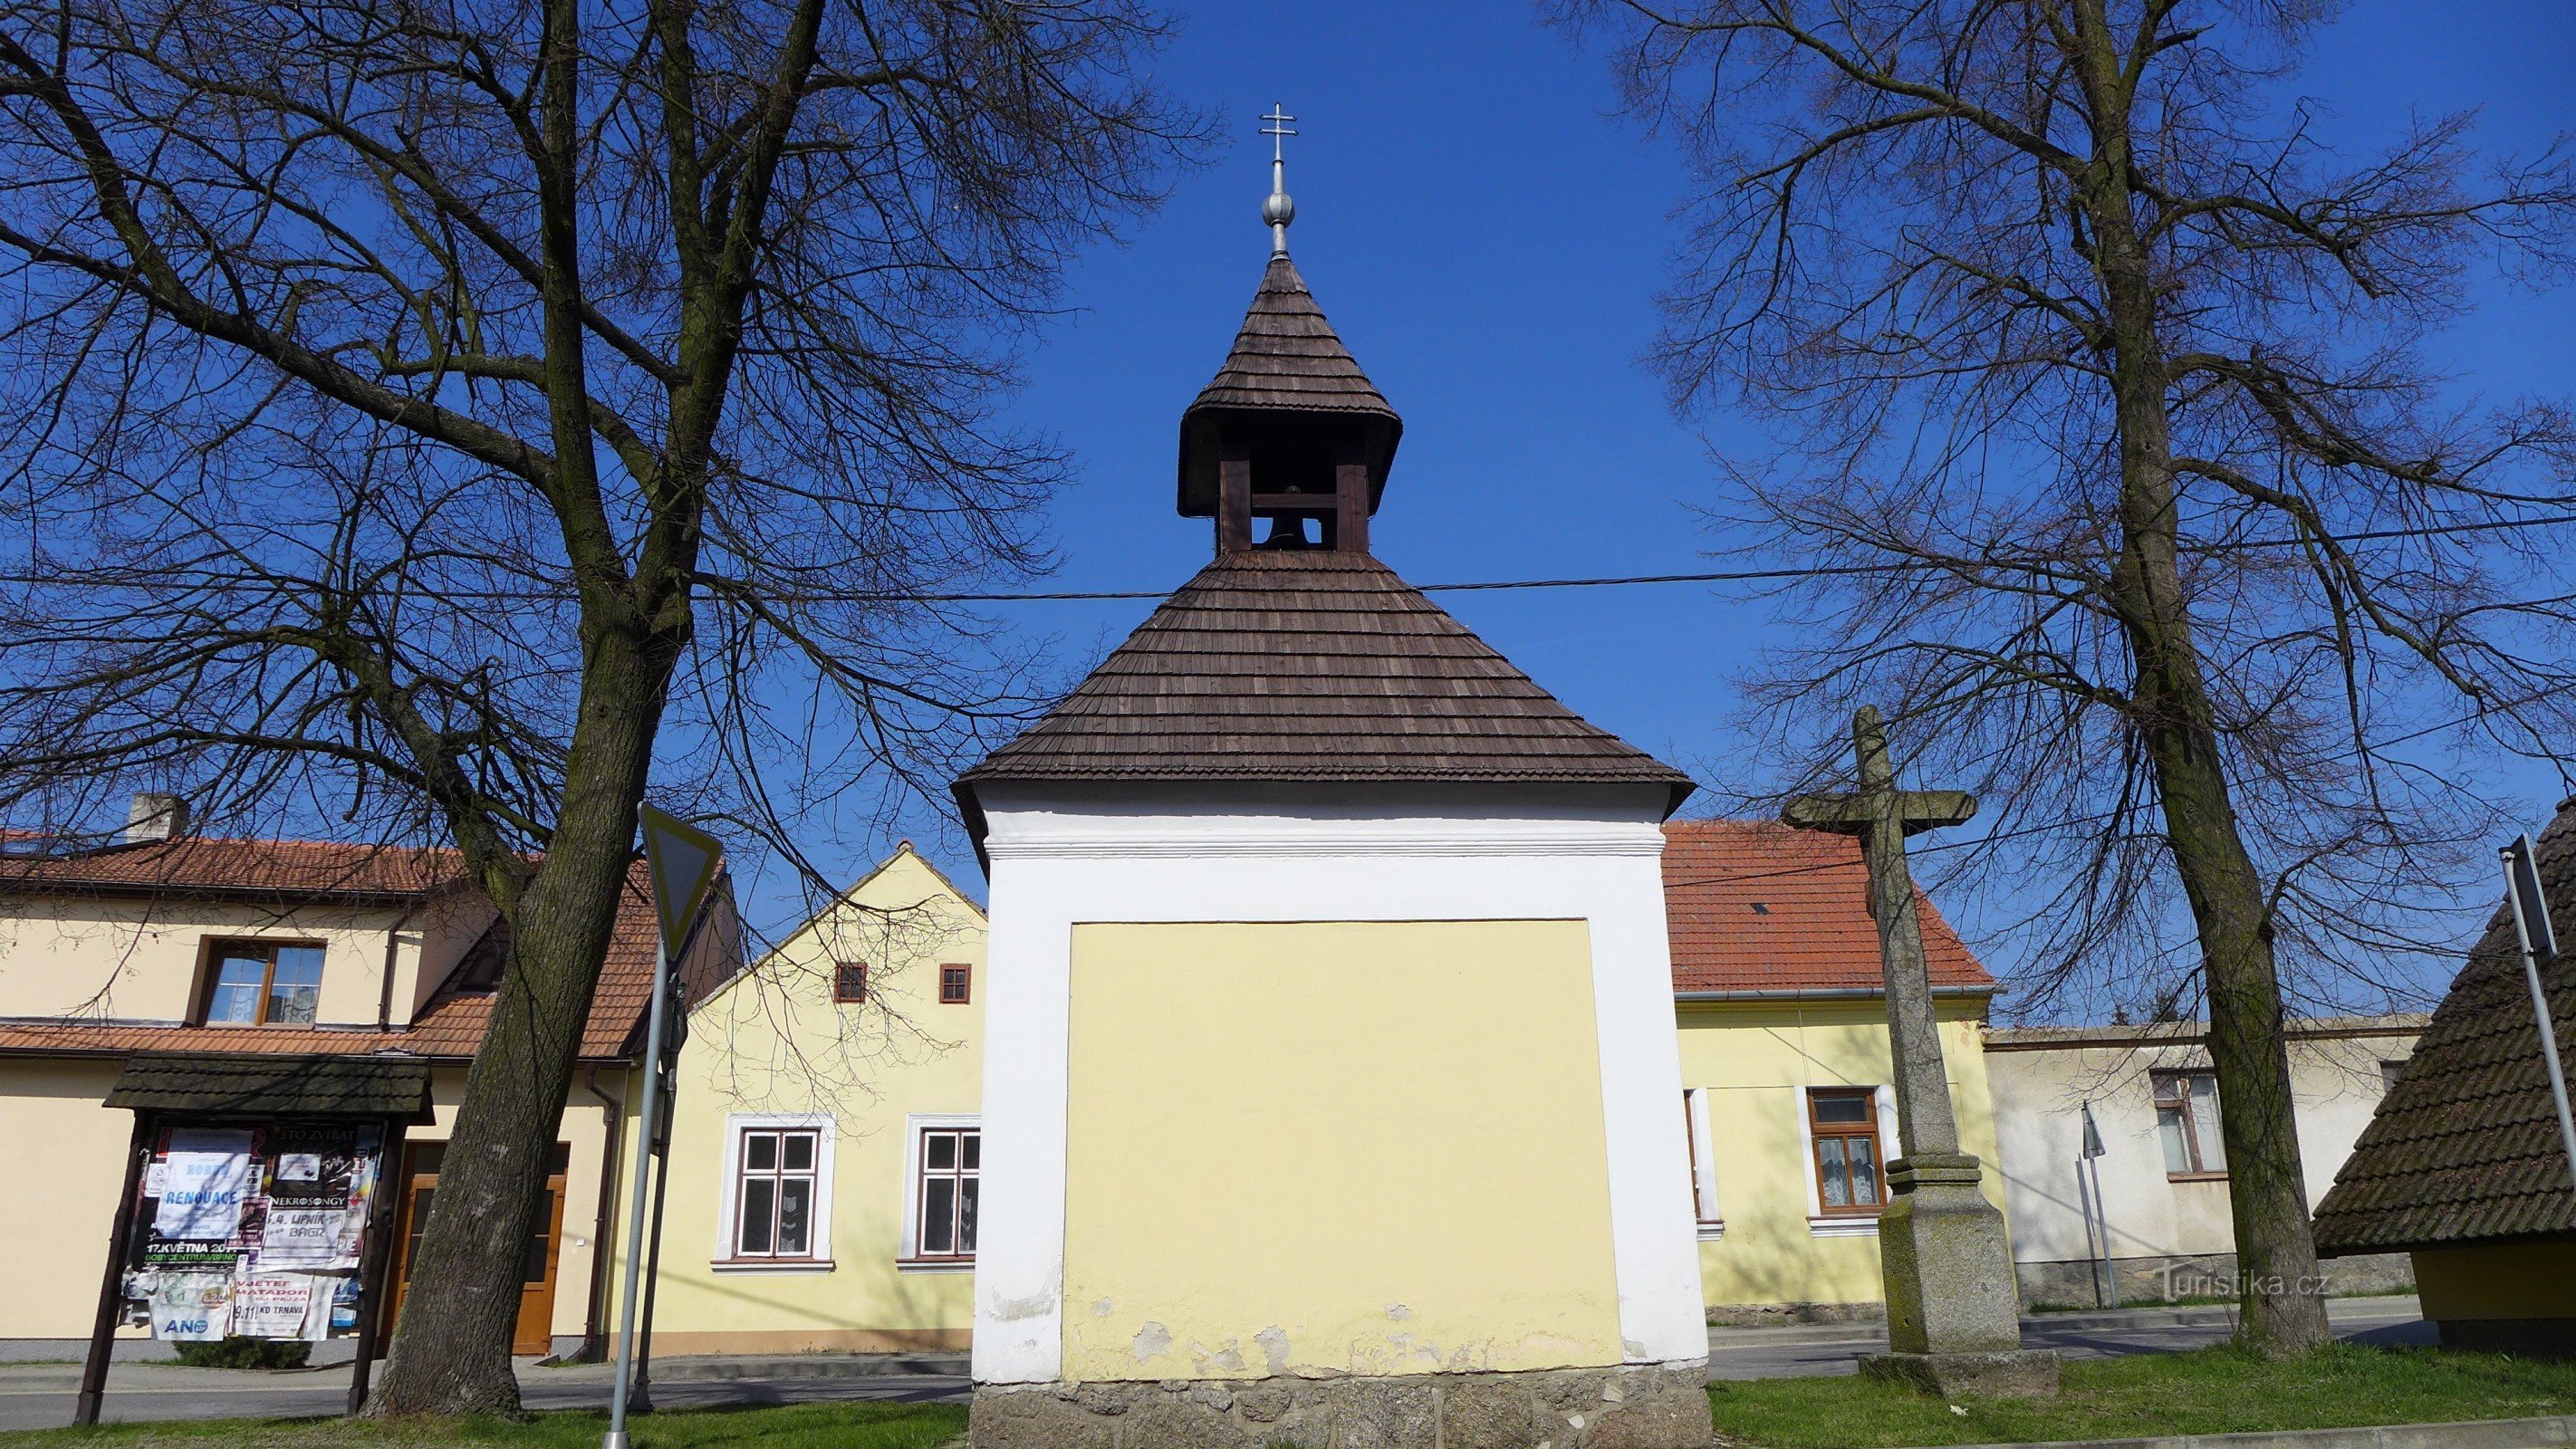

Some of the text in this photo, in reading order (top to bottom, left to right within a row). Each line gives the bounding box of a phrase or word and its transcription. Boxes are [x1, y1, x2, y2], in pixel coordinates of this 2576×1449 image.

[271, 1196, 346, 1206] NEKROSONGY
[291, 1212, 325, 1224] LIPNÍK
[274, 1306, 303, 1314] TRNAVA
[164, 1319, 208, 1333] ANO
